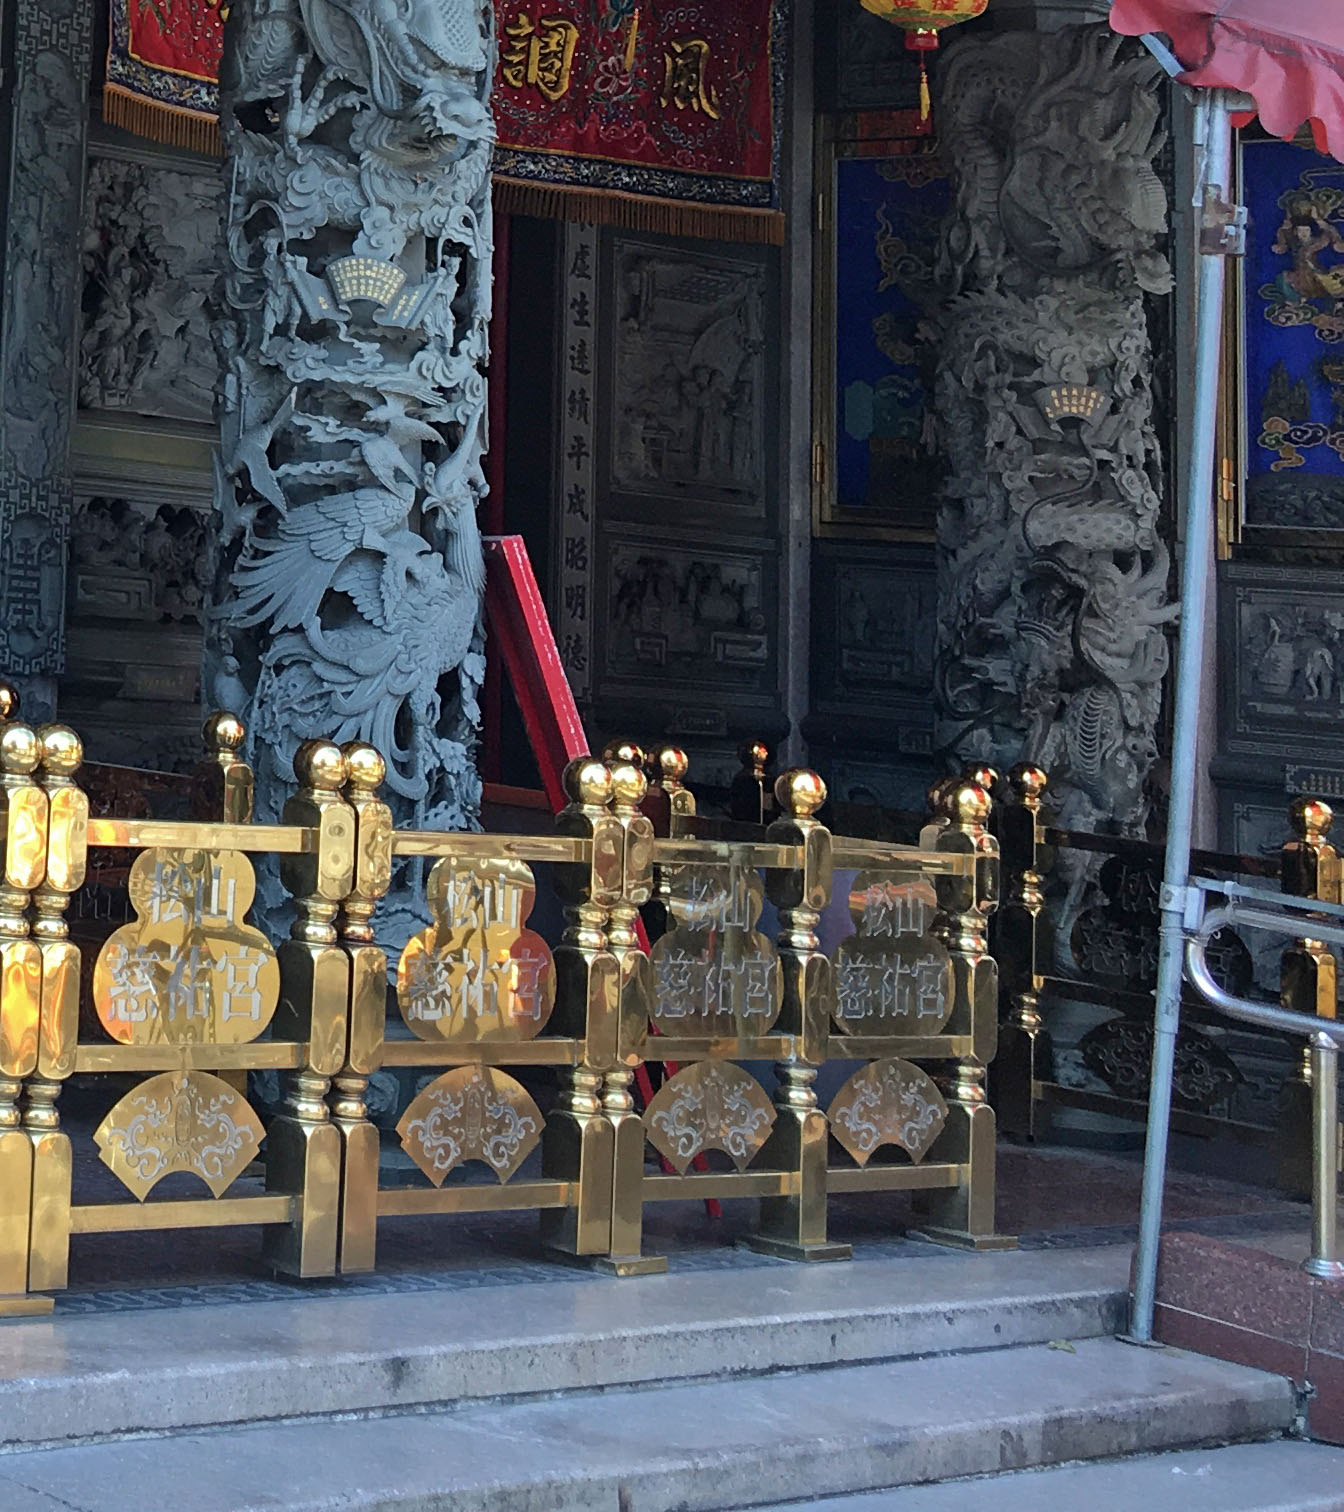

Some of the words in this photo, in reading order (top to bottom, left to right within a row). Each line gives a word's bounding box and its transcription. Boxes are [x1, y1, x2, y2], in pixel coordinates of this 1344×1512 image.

[147, 861, 238, 926] 松山
[443, 870, 519, 929] 松山
[105, 944, 269, 1023] 慈祐宮
[407, 947, 548, 1021] 慈祐宮
